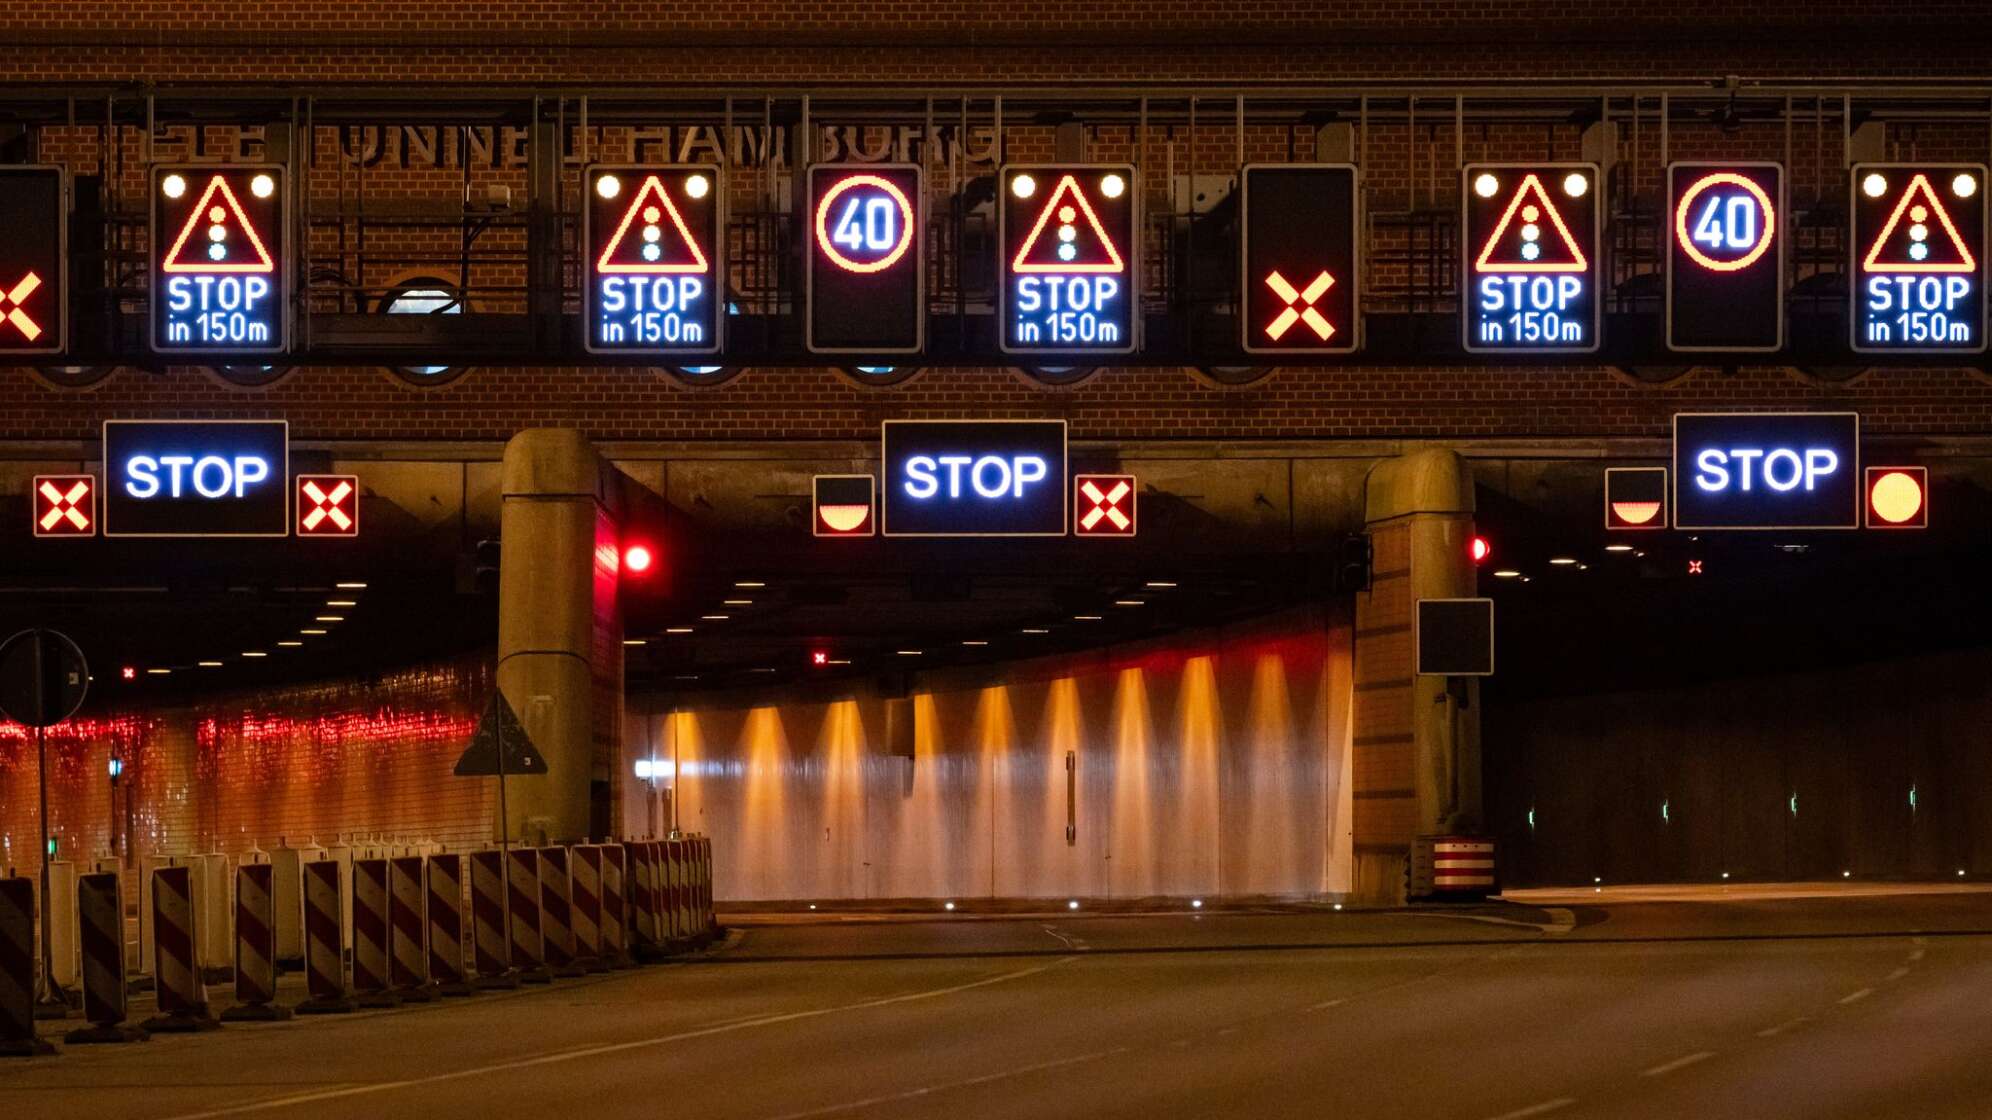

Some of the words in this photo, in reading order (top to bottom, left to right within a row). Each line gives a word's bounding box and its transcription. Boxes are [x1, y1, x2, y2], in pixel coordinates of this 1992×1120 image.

[138, 118, 594, 167] ELUNNEL
[833, 196, 896, 251] 40
[1692, 195, 1757, 249] 40
[168, 275, 269, 313] STOP
[602, 275, 703, 313] STOP
[1017, 275, 1119, 313] STOP
[1480, 275, 1582, 313] STOP
[1868, 275, 1970, 313] STOP
[168, 314, 190, 342] in
[602, 314, 624, 342] in
[1017, 314, 1040, 342] in
[1480, 314, 1503, 342] in
[1868, 314, 1891, 342] in
[125, 454, 270, 499] STOP
[903, 455, 1048, 500] STOP
[1695, 447, 1839, 492] STOP
